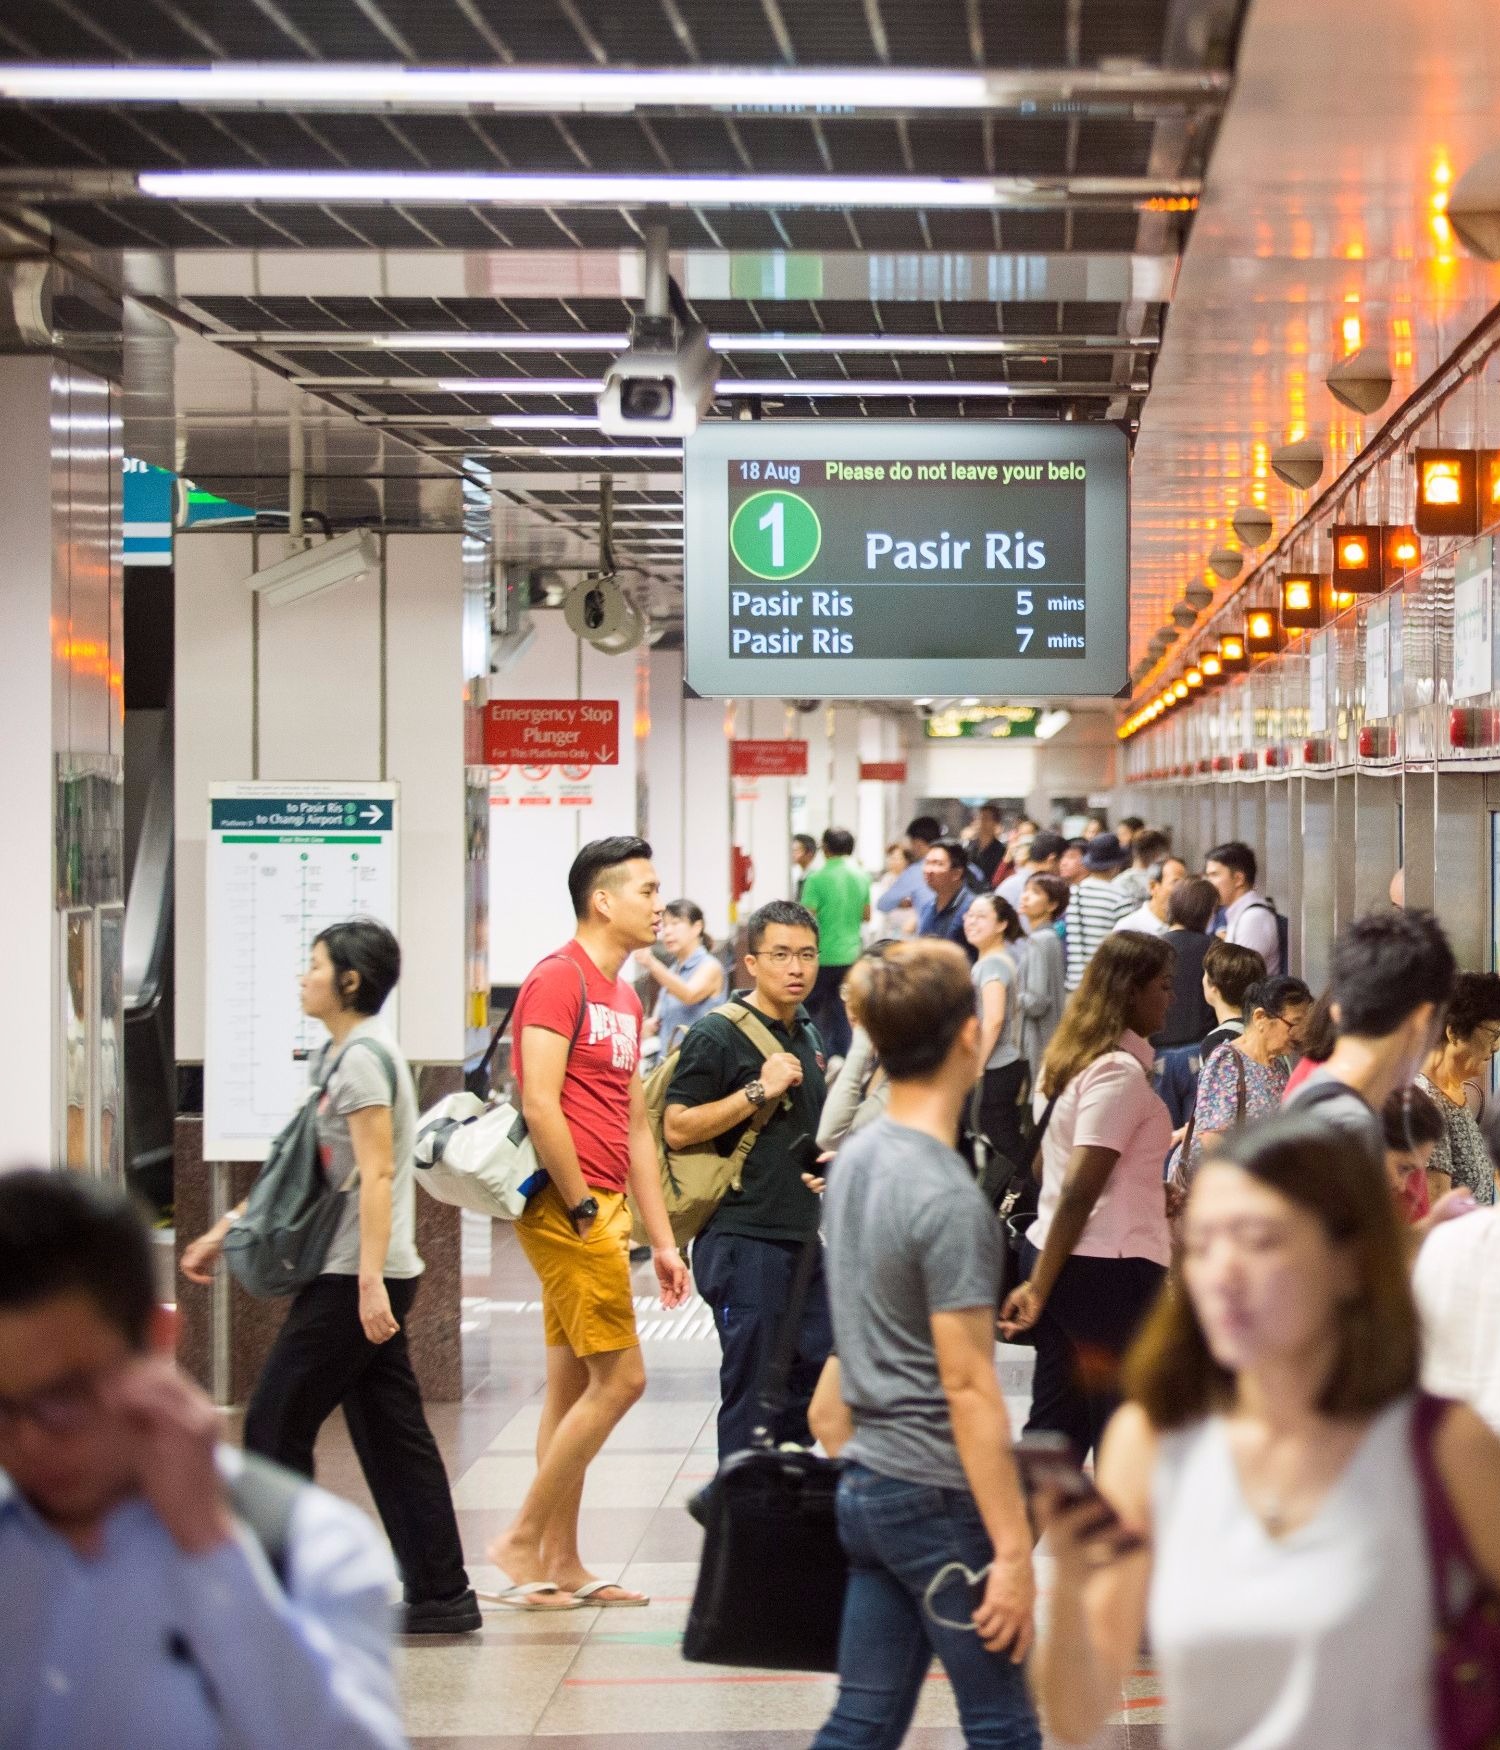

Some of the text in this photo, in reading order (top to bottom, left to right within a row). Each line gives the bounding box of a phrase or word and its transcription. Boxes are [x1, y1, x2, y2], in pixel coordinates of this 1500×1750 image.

[740, 462, 801, 486] 18 Aug
[825, 461, 1086, 486] Please do not leave your belo
[759, 502, 785, 567] 1
[866, 531, 1046, 570] Pasir Ris
[732, 591, 1085, 617] Pasir Ris 5 mins
[732, 628, 1085, 654] Pasir Ris 7 mins
[491, 705, 613, 725] Emergency Stop
[523, 727, 581, 747] Plunger
[286, 802, 343, 813] to Pasir Ris
[256, 814, 269, 825] to
[306, 814, 343, 826] Airport
